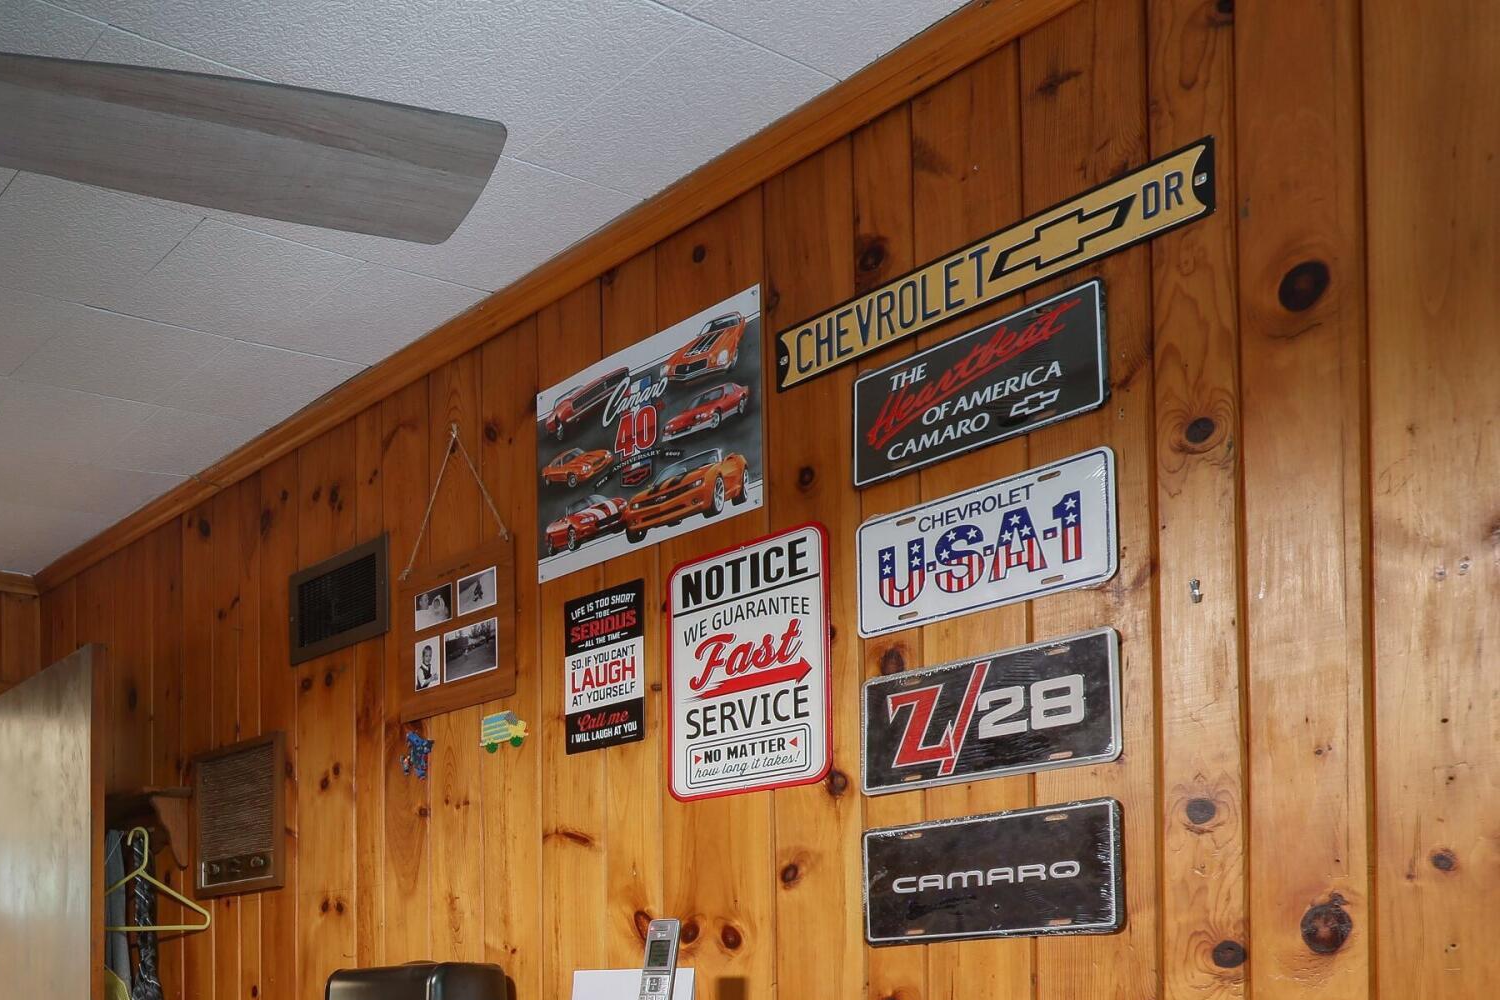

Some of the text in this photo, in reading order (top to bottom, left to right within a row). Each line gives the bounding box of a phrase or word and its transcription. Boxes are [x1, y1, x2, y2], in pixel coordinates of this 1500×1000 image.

[796, 169, 1185, 374] CHEVROLET DR
[867, 299, 1082, 447] Heartbeat
[889, 362, 928, 392] THE
[602, 376, 668, 427] Camaro
[921, 360, 1063, 426] OF AMERICA
[615, 405, 657, 457] 40
[887, 412, 990, 461] CAMARO
[612, 449, 661, 472] ANNIVERSARY
[918, 483, 1035, 533] CHEVROLET
[681, 536, 809, 609] NOTICE
[570, 593, 636, 620] LIFE IS TOO SHORT
[595, 609, 610, 619] TO BE
[684, 596, 810, 647] WE GUARANTEE
[571, 608, 637, 644] SERIOUS
[585, 632, 621, 648] ALL THE TIME
[585, 655, 592, 667] IF
[593, 650, 609, 663] YOU
[611, 644, 636, 661] CAN'T
[689, 618, 803, 691] Fast
[571, 656, 636, 694] LAUGH
[572, 681, 636, 707] AT YOURSELF
[686, 684, 810, 740] SERVICE
[575, 732, 590, 743] WILL
[591, 728, 613, 741] LAUGH
[614, 725, 622, 736] AT
[623, 721, 637, 733] YOU
[577, 710, 629, 732] Call me
[694, 750, 801, 779] how long it takes!
[704, 737, 786, 764] NO MATTER
[892, 860, 1081, 894] CAMARO
